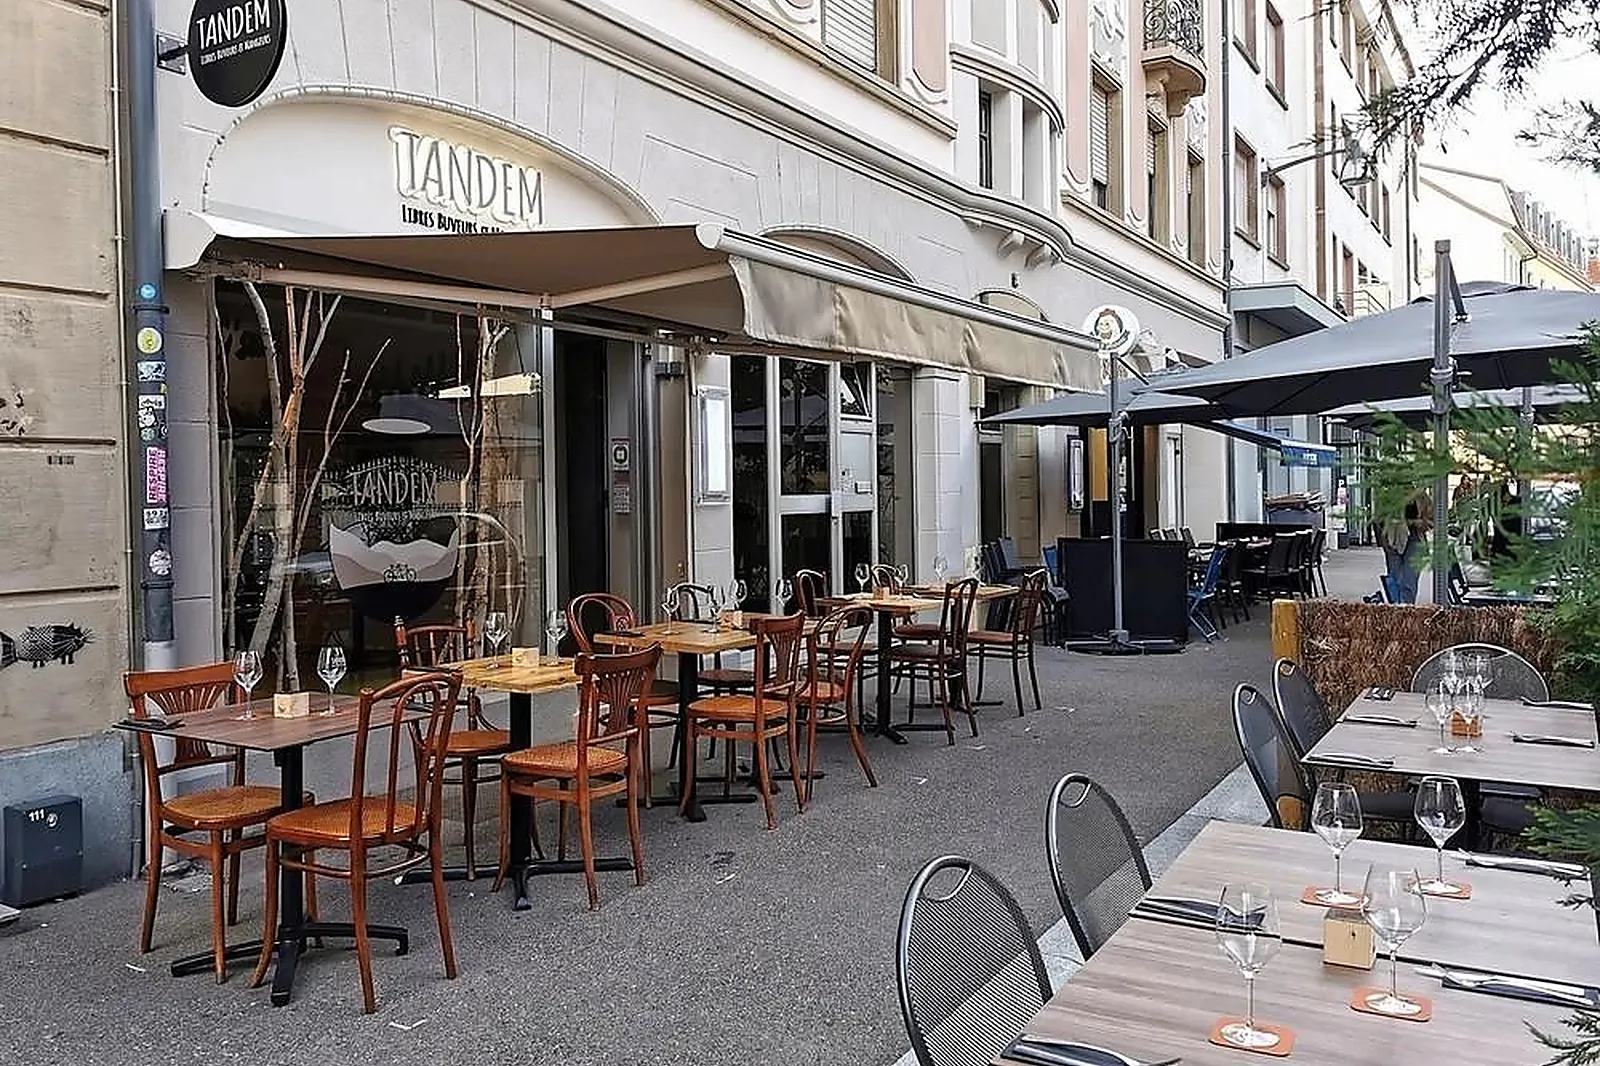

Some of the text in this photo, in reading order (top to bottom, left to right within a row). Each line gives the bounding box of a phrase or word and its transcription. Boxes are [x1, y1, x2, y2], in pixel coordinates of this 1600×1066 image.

[197, 0, 270, 50] TANDEM
[392, 129, 544, 227] TANDEM
[148, 448, 157, 501] RESPIRE
[353, 471, 437, 506] TANDEM
[28, 808, 45, 822] 111
